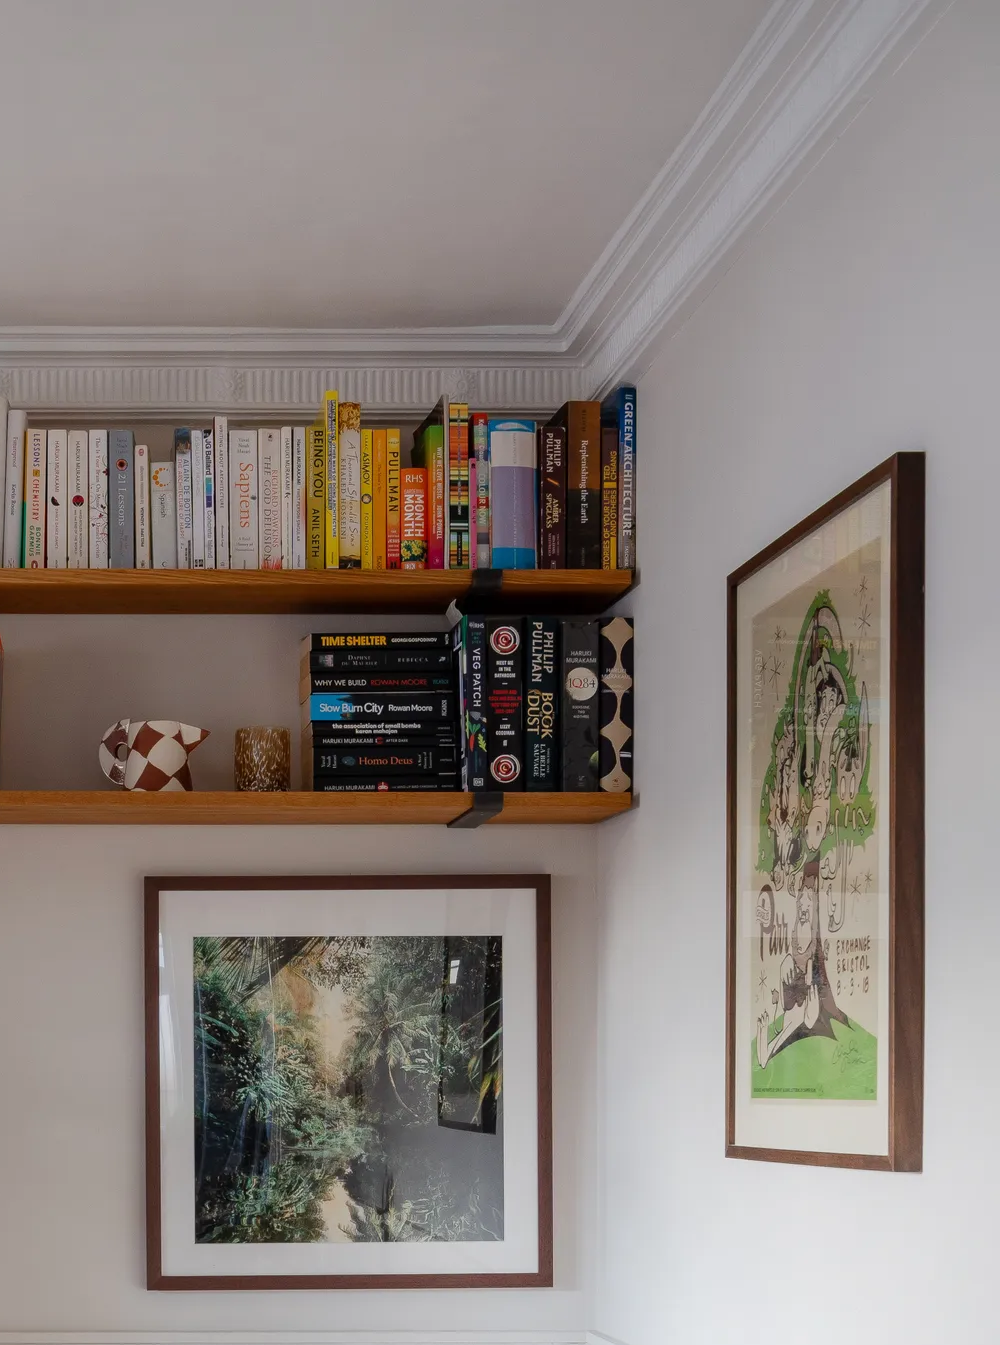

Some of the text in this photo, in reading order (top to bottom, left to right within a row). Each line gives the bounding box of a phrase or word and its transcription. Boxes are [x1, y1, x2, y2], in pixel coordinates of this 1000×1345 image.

[205, 439, 211, 449] JG
[553, 439, 561, 466] PHILIP
[118, 474, 125, 484] 21
[313, 430, 323, 498] BEING YOU
[362, 452, 370, 485] ASIMOV
[405, 475, 423, 483] RHS
[579, 440, 588, 489] Replenishing
[623, 402, 633, 536] GREEN ARCHITECTURE
[184, 486, 190, 495] DE
[235, 463, 254, 527] Sapiens
[346, 439, 359, 546] A Thousand Splendid Suns
[388, 452, 399, 512] PULLMAN
[478, 473, 486, 504] COLOUR
[580, 490, 588, 501] the
[118, 488, 126, 526] Lessons
[404, 494, 414, 536] MONTH
[415, 494, 424, 536] MONTH
[580, 503, 588, 523] Earth
[603, 528, 610, 538] OF
[321, 636, 345, 646] TIME
[347, 636, 387, 646] SHELTER
[531, 621, 542, 682] PULLMAN
[543, 632, 553, 673] PHILIP
[472, 648, 481, 707] VEG PATCH
[570, 678, 595, 689] 1Q84
[320, 703, 341, 712] Slow
[342, 704, 363, 712] Burn
[364, 703, 384, 715] City
[527, 695, 539, 735] DUST
[541, 692, 552, 739] BOOK
[359, 757, 388, 765] Homo
[391, 757, 413, 765] Deus
[540, 744, 545, 753] LA
[837, 935, 870, 956] EXCHANGE
[837, 962, 870, 974] BRISTOL
